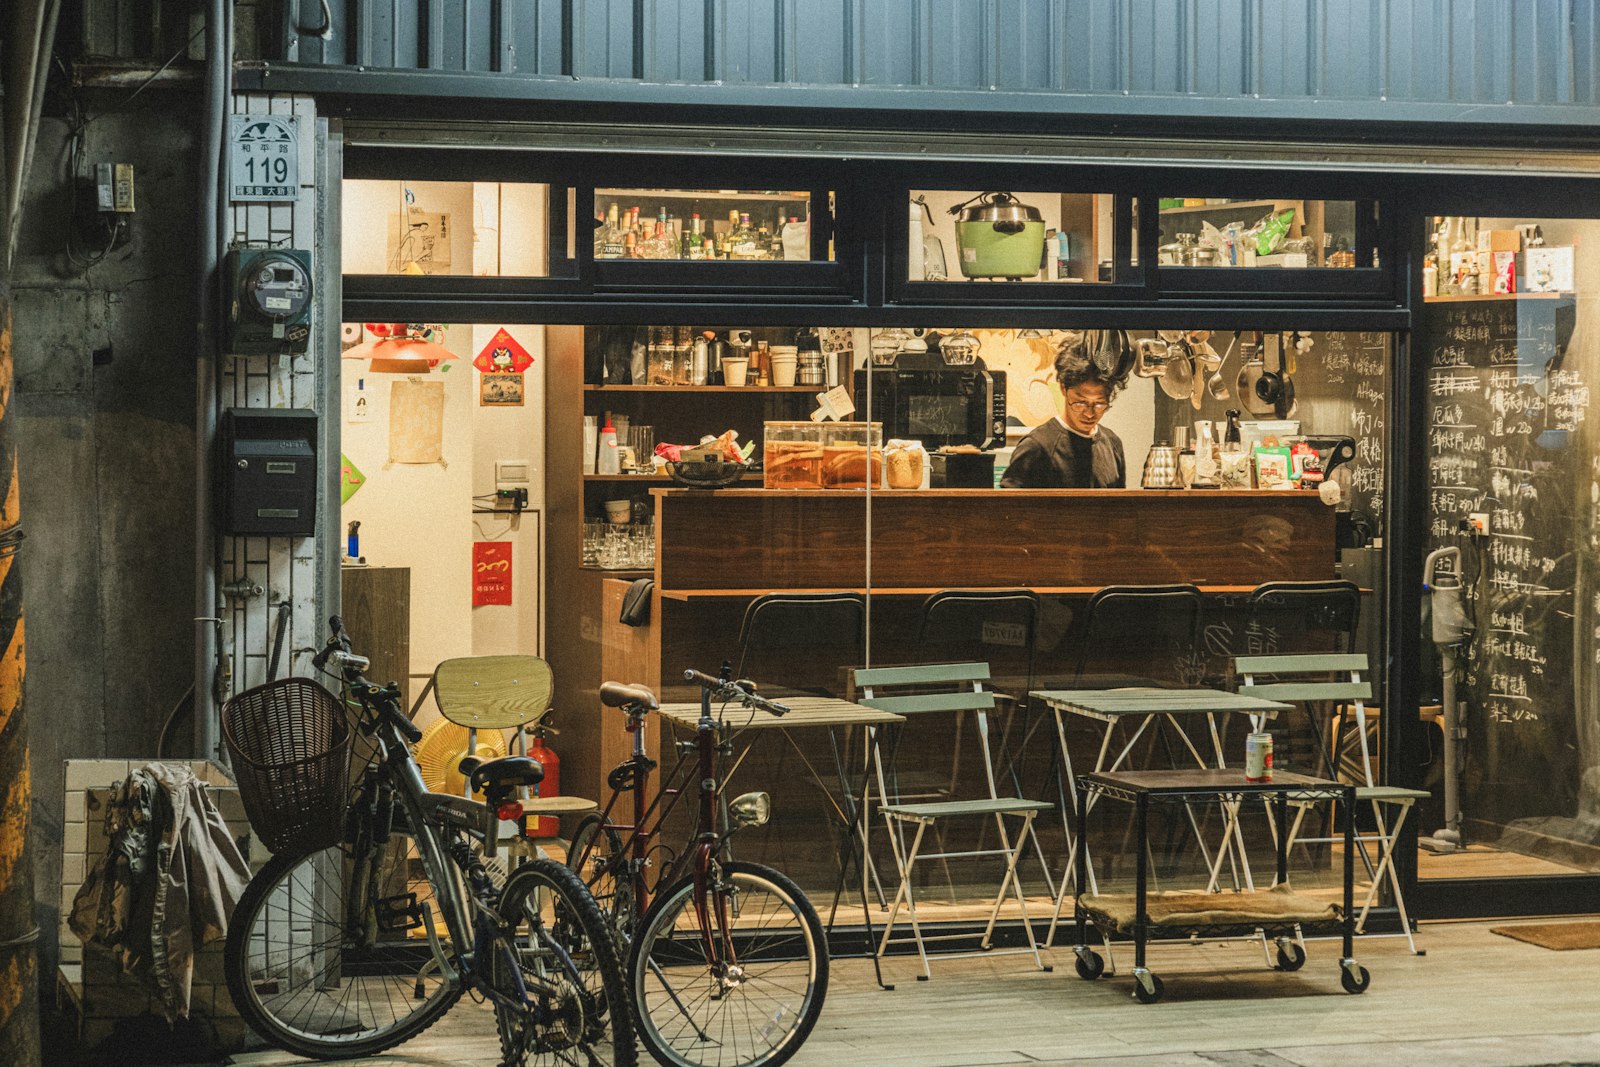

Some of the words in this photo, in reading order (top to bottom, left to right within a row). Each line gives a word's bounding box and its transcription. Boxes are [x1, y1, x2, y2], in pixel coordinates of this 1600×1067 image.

[242, 144, 289, 153] 和平路
[245, 157, 288, 183] 119
